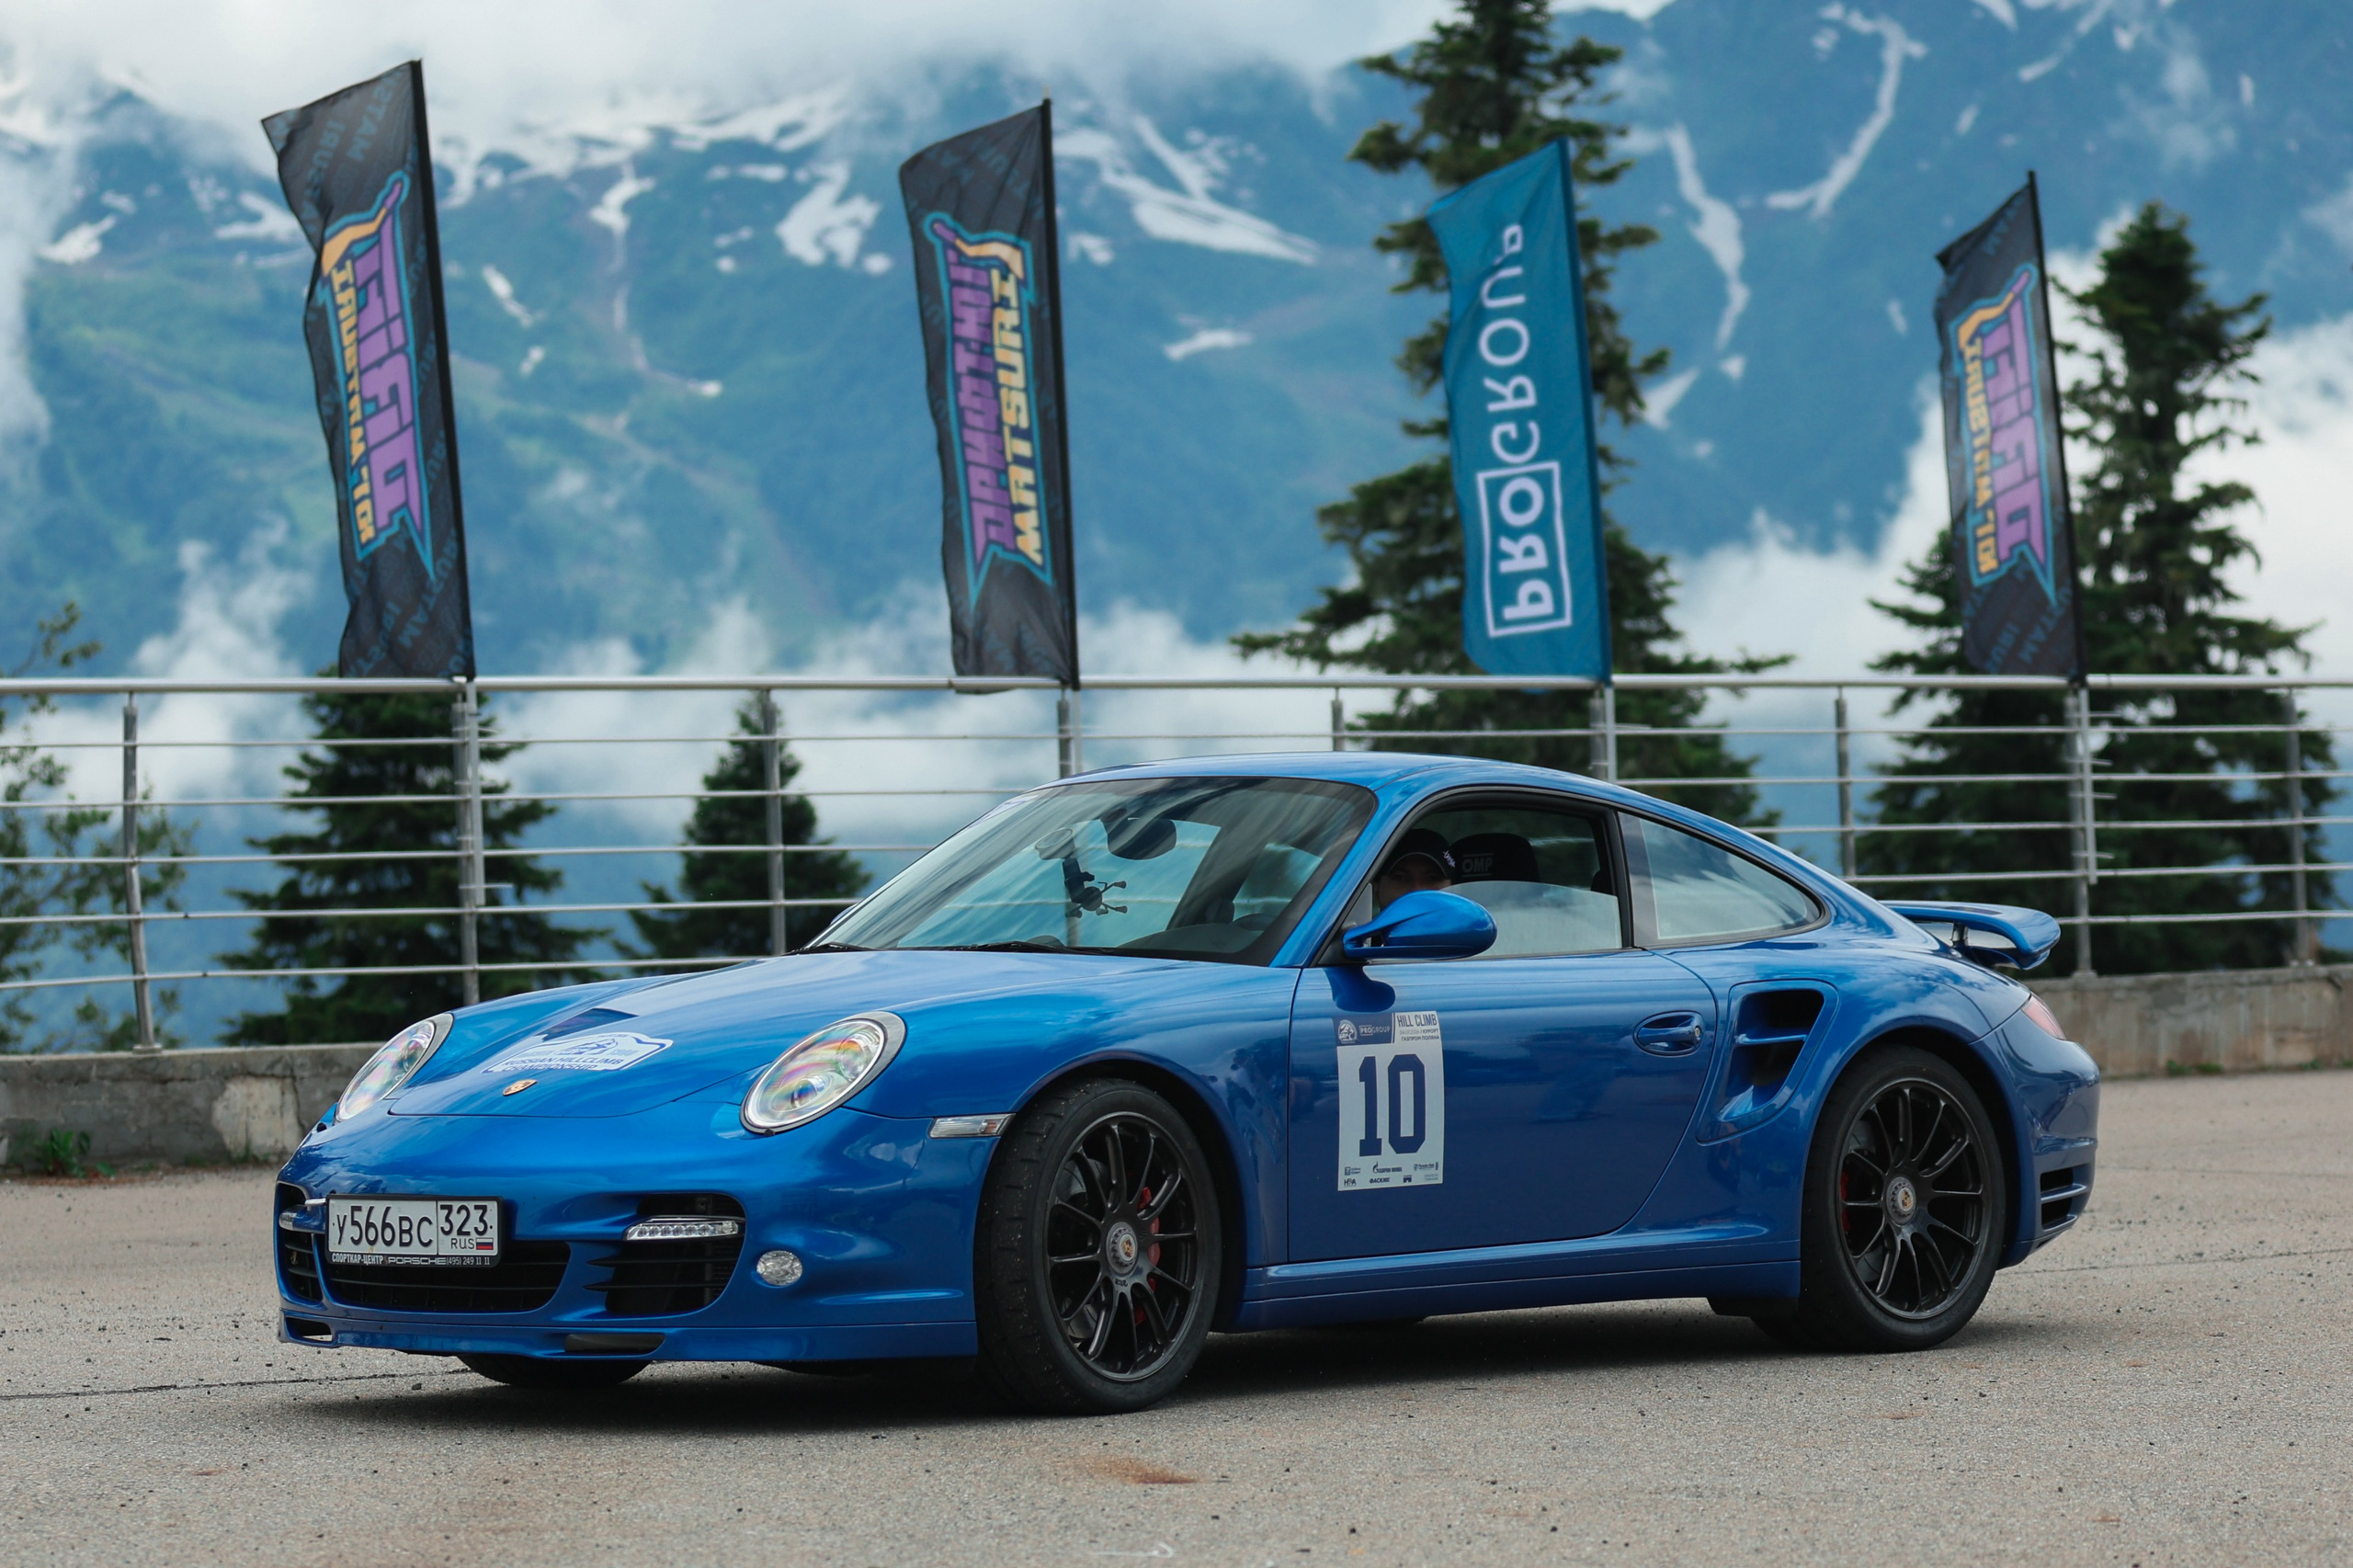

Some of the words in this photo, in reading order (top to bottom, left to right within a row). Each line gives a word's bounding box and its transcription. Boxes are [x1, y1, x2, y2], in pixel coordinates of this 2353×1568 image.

[991, 268, 1044, 566] MATSURI
[1462, 857, 1493, 873] OMP
[1396, 1015, 1414, 1028] HILL
[1415, 1014, 1438, 1027] CLIMB
[1358, 1053, 1426, 1157] 10
[439, 1204, 488, 1236] 323
[450, 1238, 475, 1250] RUS
[332, 1253, 384, 1266] СПОРТКАР-ЦЕНТР
[388, 1256, 447, 1265] PORSCHE
[462, 1256, 474, 1266] 249
